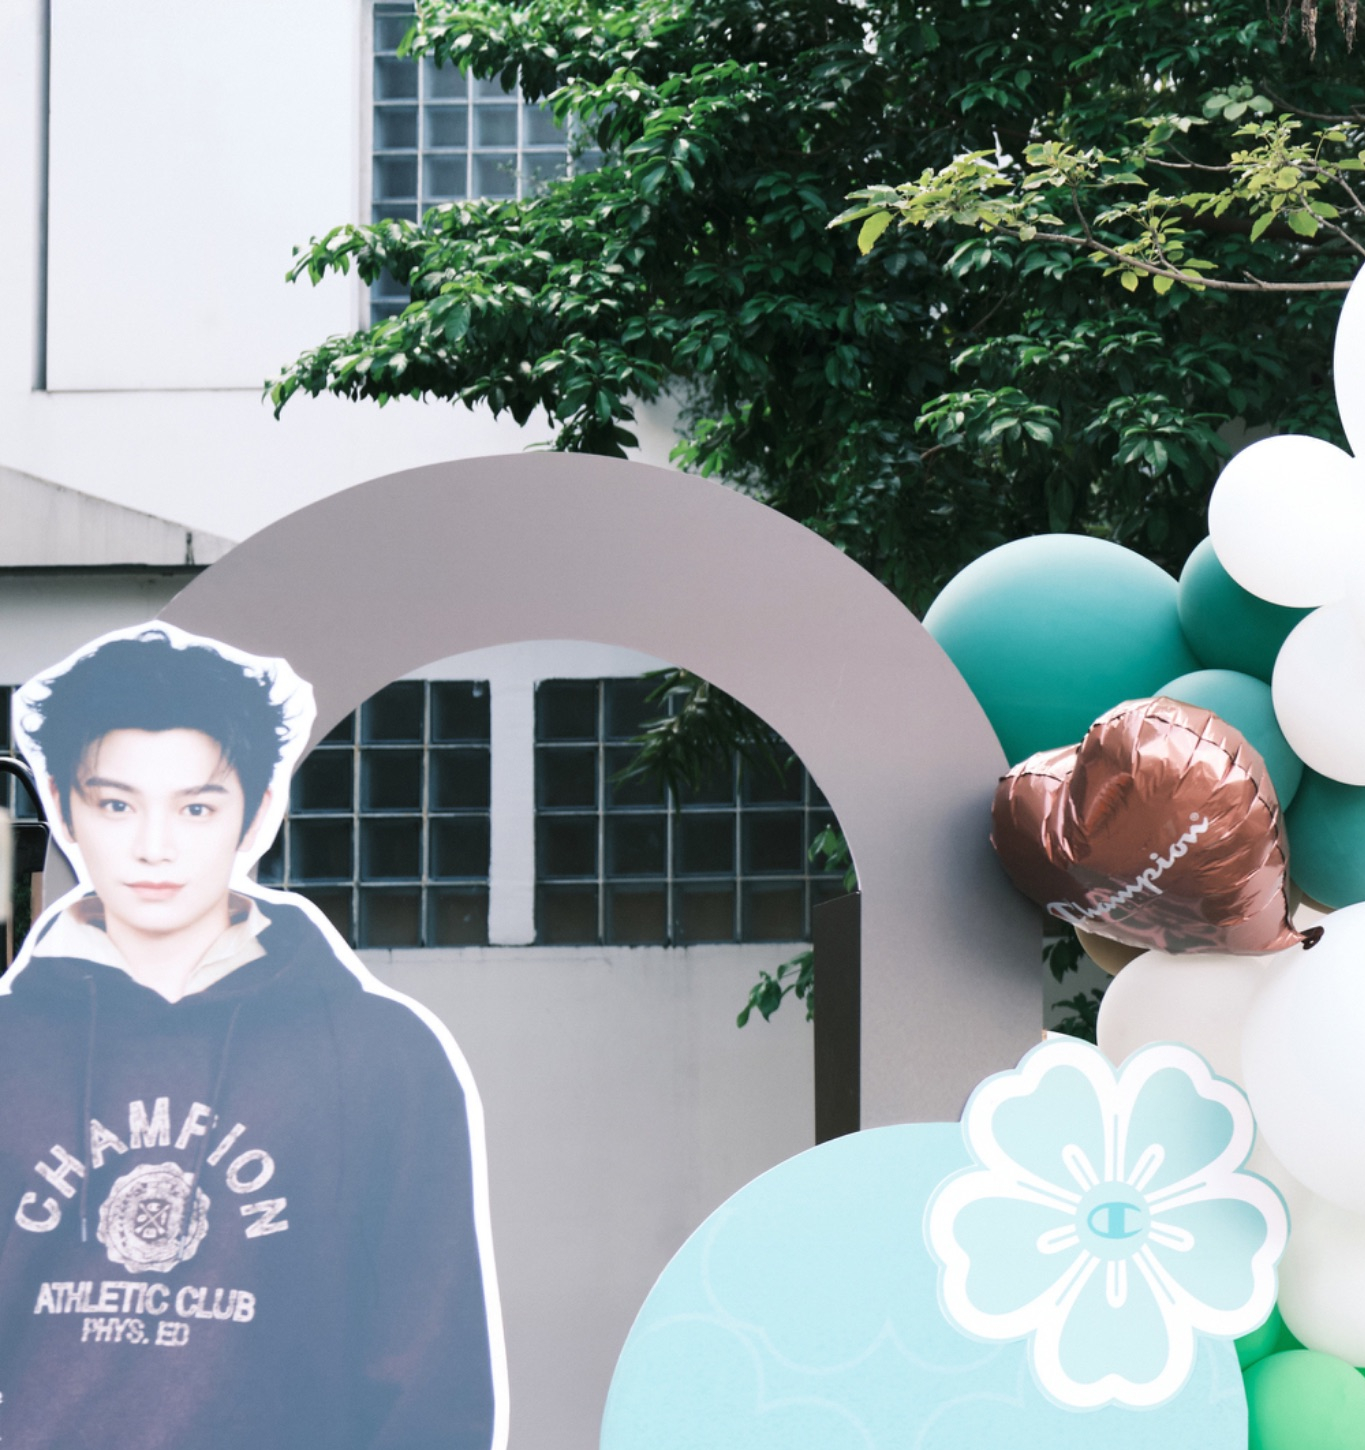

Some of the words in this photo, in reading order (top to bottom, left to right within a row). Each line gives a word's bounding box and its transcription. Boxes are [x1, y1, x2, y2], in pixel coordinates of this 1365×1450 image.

[14, 1096, 289, 1239] CHAMPION
[34, 1281, 170, 1315] ATHLETIC
[175, 1286, 256, 1323] CLUB
